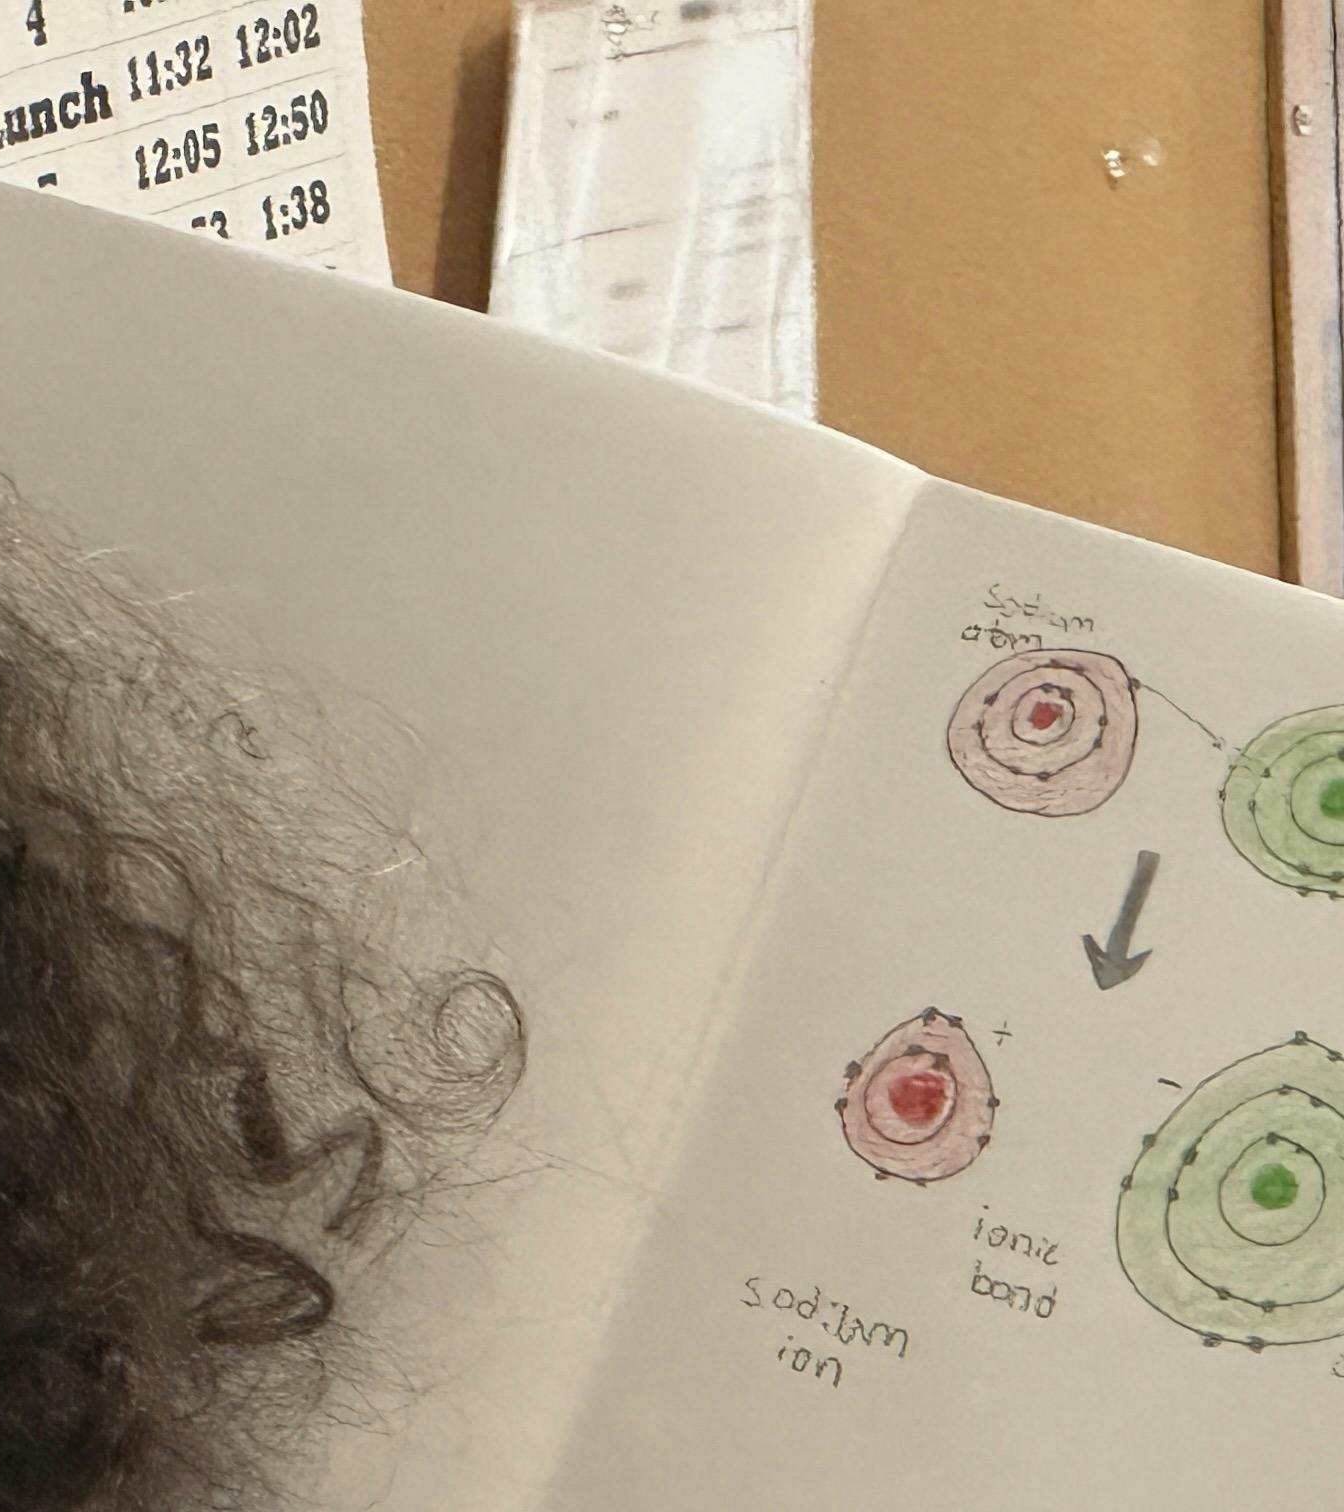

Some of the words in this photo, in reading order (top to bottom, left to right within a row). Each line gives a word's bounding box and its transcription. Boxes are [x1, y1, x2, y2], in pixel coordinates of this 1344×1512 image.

[127, 34, 213, 101] 11:32
[236, 3, 321, 69] 12:02
[135, 123, 221, 190] 12:05
[246, 89, 329, 156] 12:50
[262, 179, 331, 240] 1:38
[973, 1204, 1059, 1265] ionic
[971, 1259, 1057, 1319] bond
[777, 1335, 843, 1388] ion
